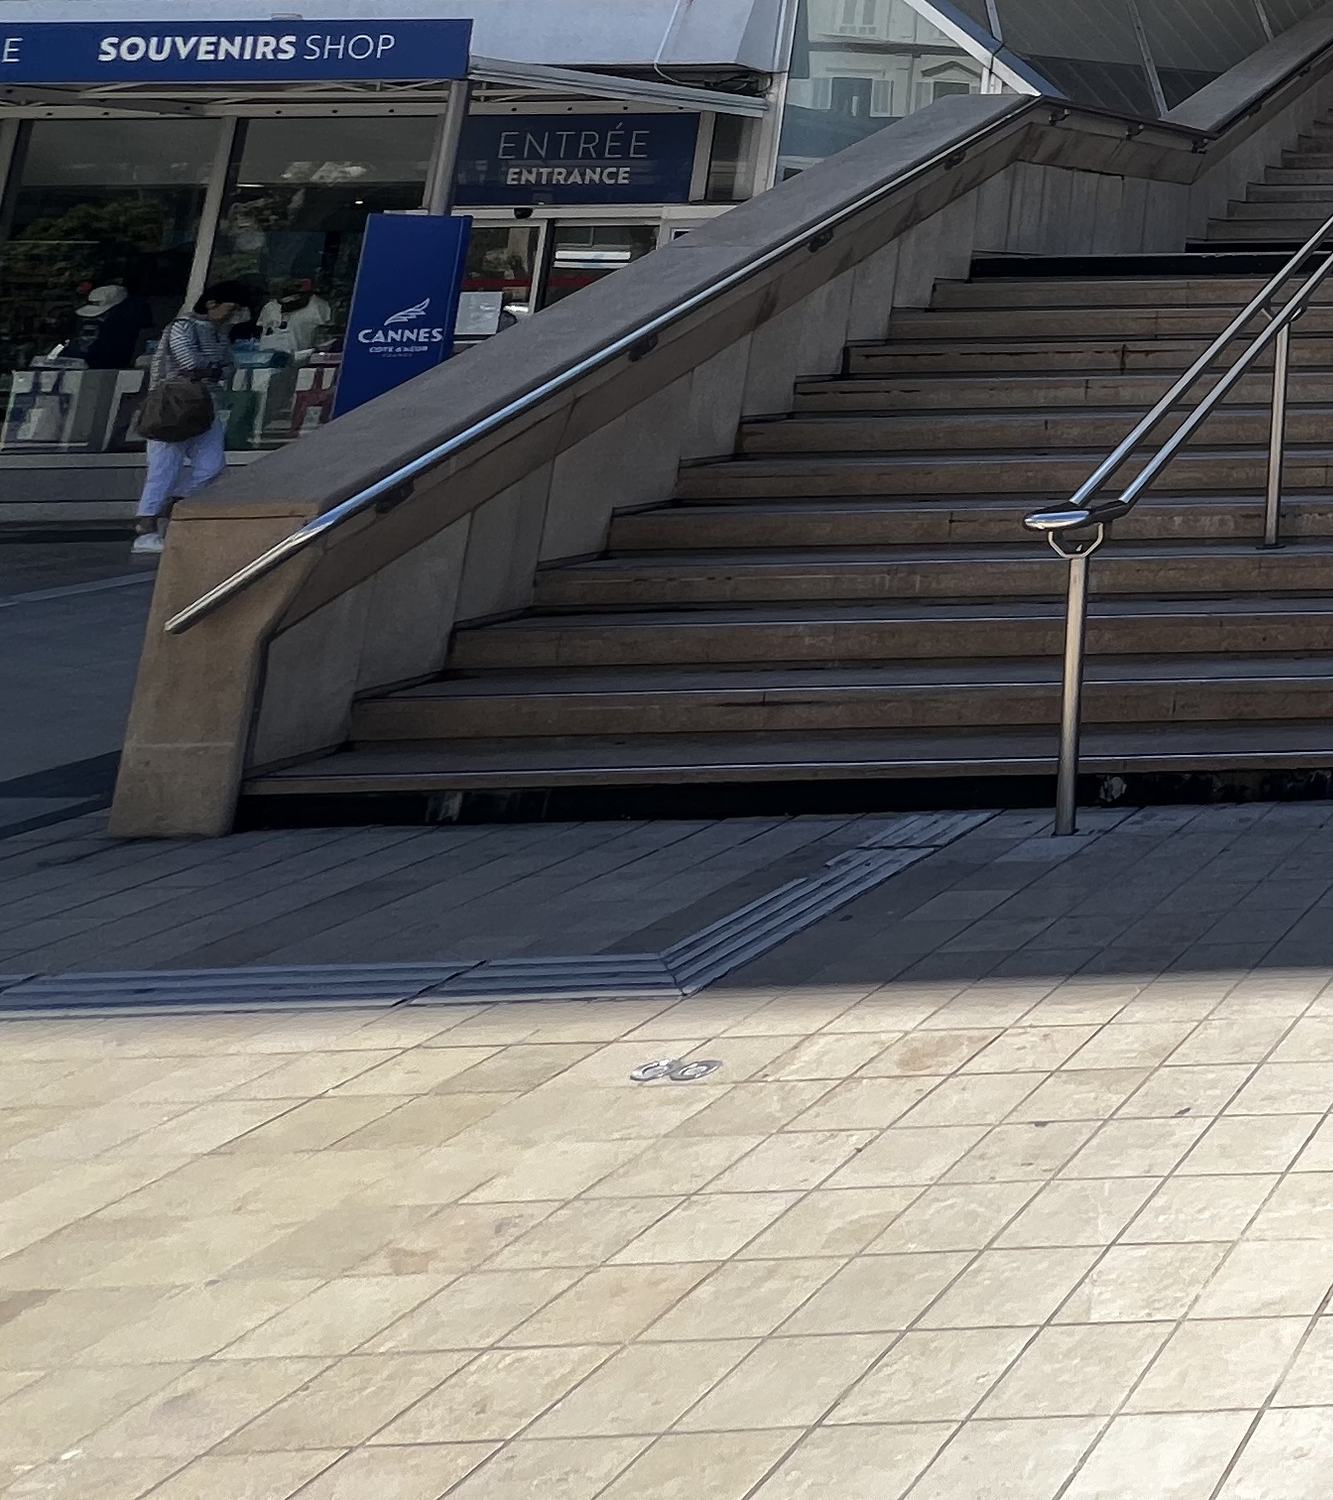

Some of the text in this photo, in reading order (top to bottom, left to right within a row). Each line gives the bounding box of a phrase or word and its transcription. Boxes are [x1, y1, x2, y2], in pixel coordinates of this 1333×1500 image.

[98, 35, 298, 62] SOUVENIRS
[303, 34, 395, 60] SHOP
[497, 121, 651, 159] ENTRÉE
[506, 167, 631, 185] ENTRANCE
[357, 328, 444, 343] CANNES
